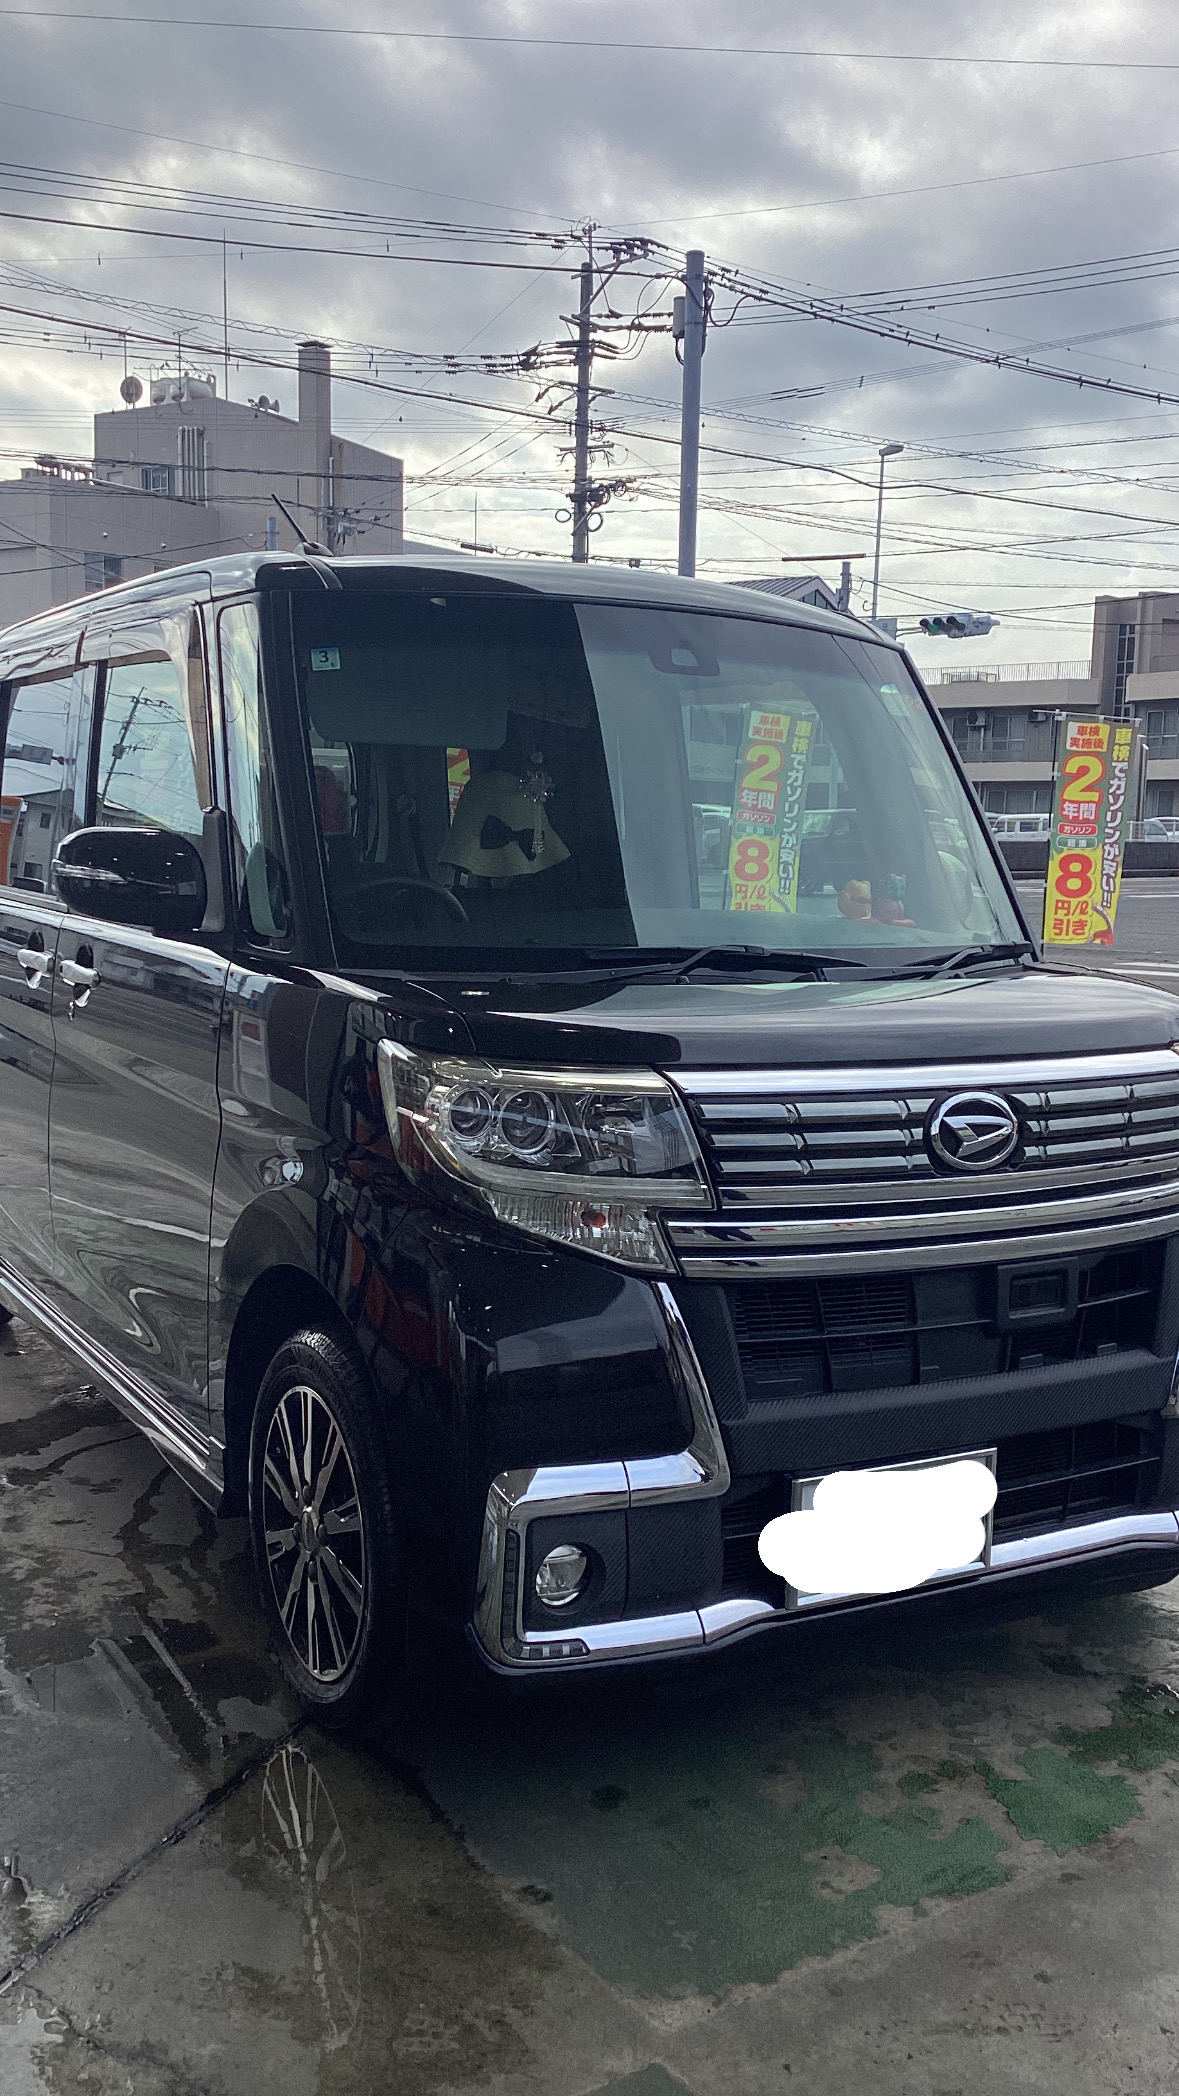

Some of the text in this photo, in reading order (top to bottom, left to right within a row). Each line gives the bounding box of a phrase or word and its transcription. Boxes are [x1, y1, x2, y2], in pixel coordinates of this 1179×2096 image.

[319, 650, 329, 663] 3
[1076, 725, 1100, 737] 車検
[1069, 737, 1104, 750] 実施後
[742, 744, 782, 792] 2
[1062, 755, 1103, 802] 2
[740, 789, 775, 810] 年間
[1062, 802, 1096, 820] 年間
[1063, 826, 1092, 834] ガソリン
[734, 839, 770, 882] 8
[1055, 853, 1092, 899] 8
[1052, 918, 1088, 937] 引き
